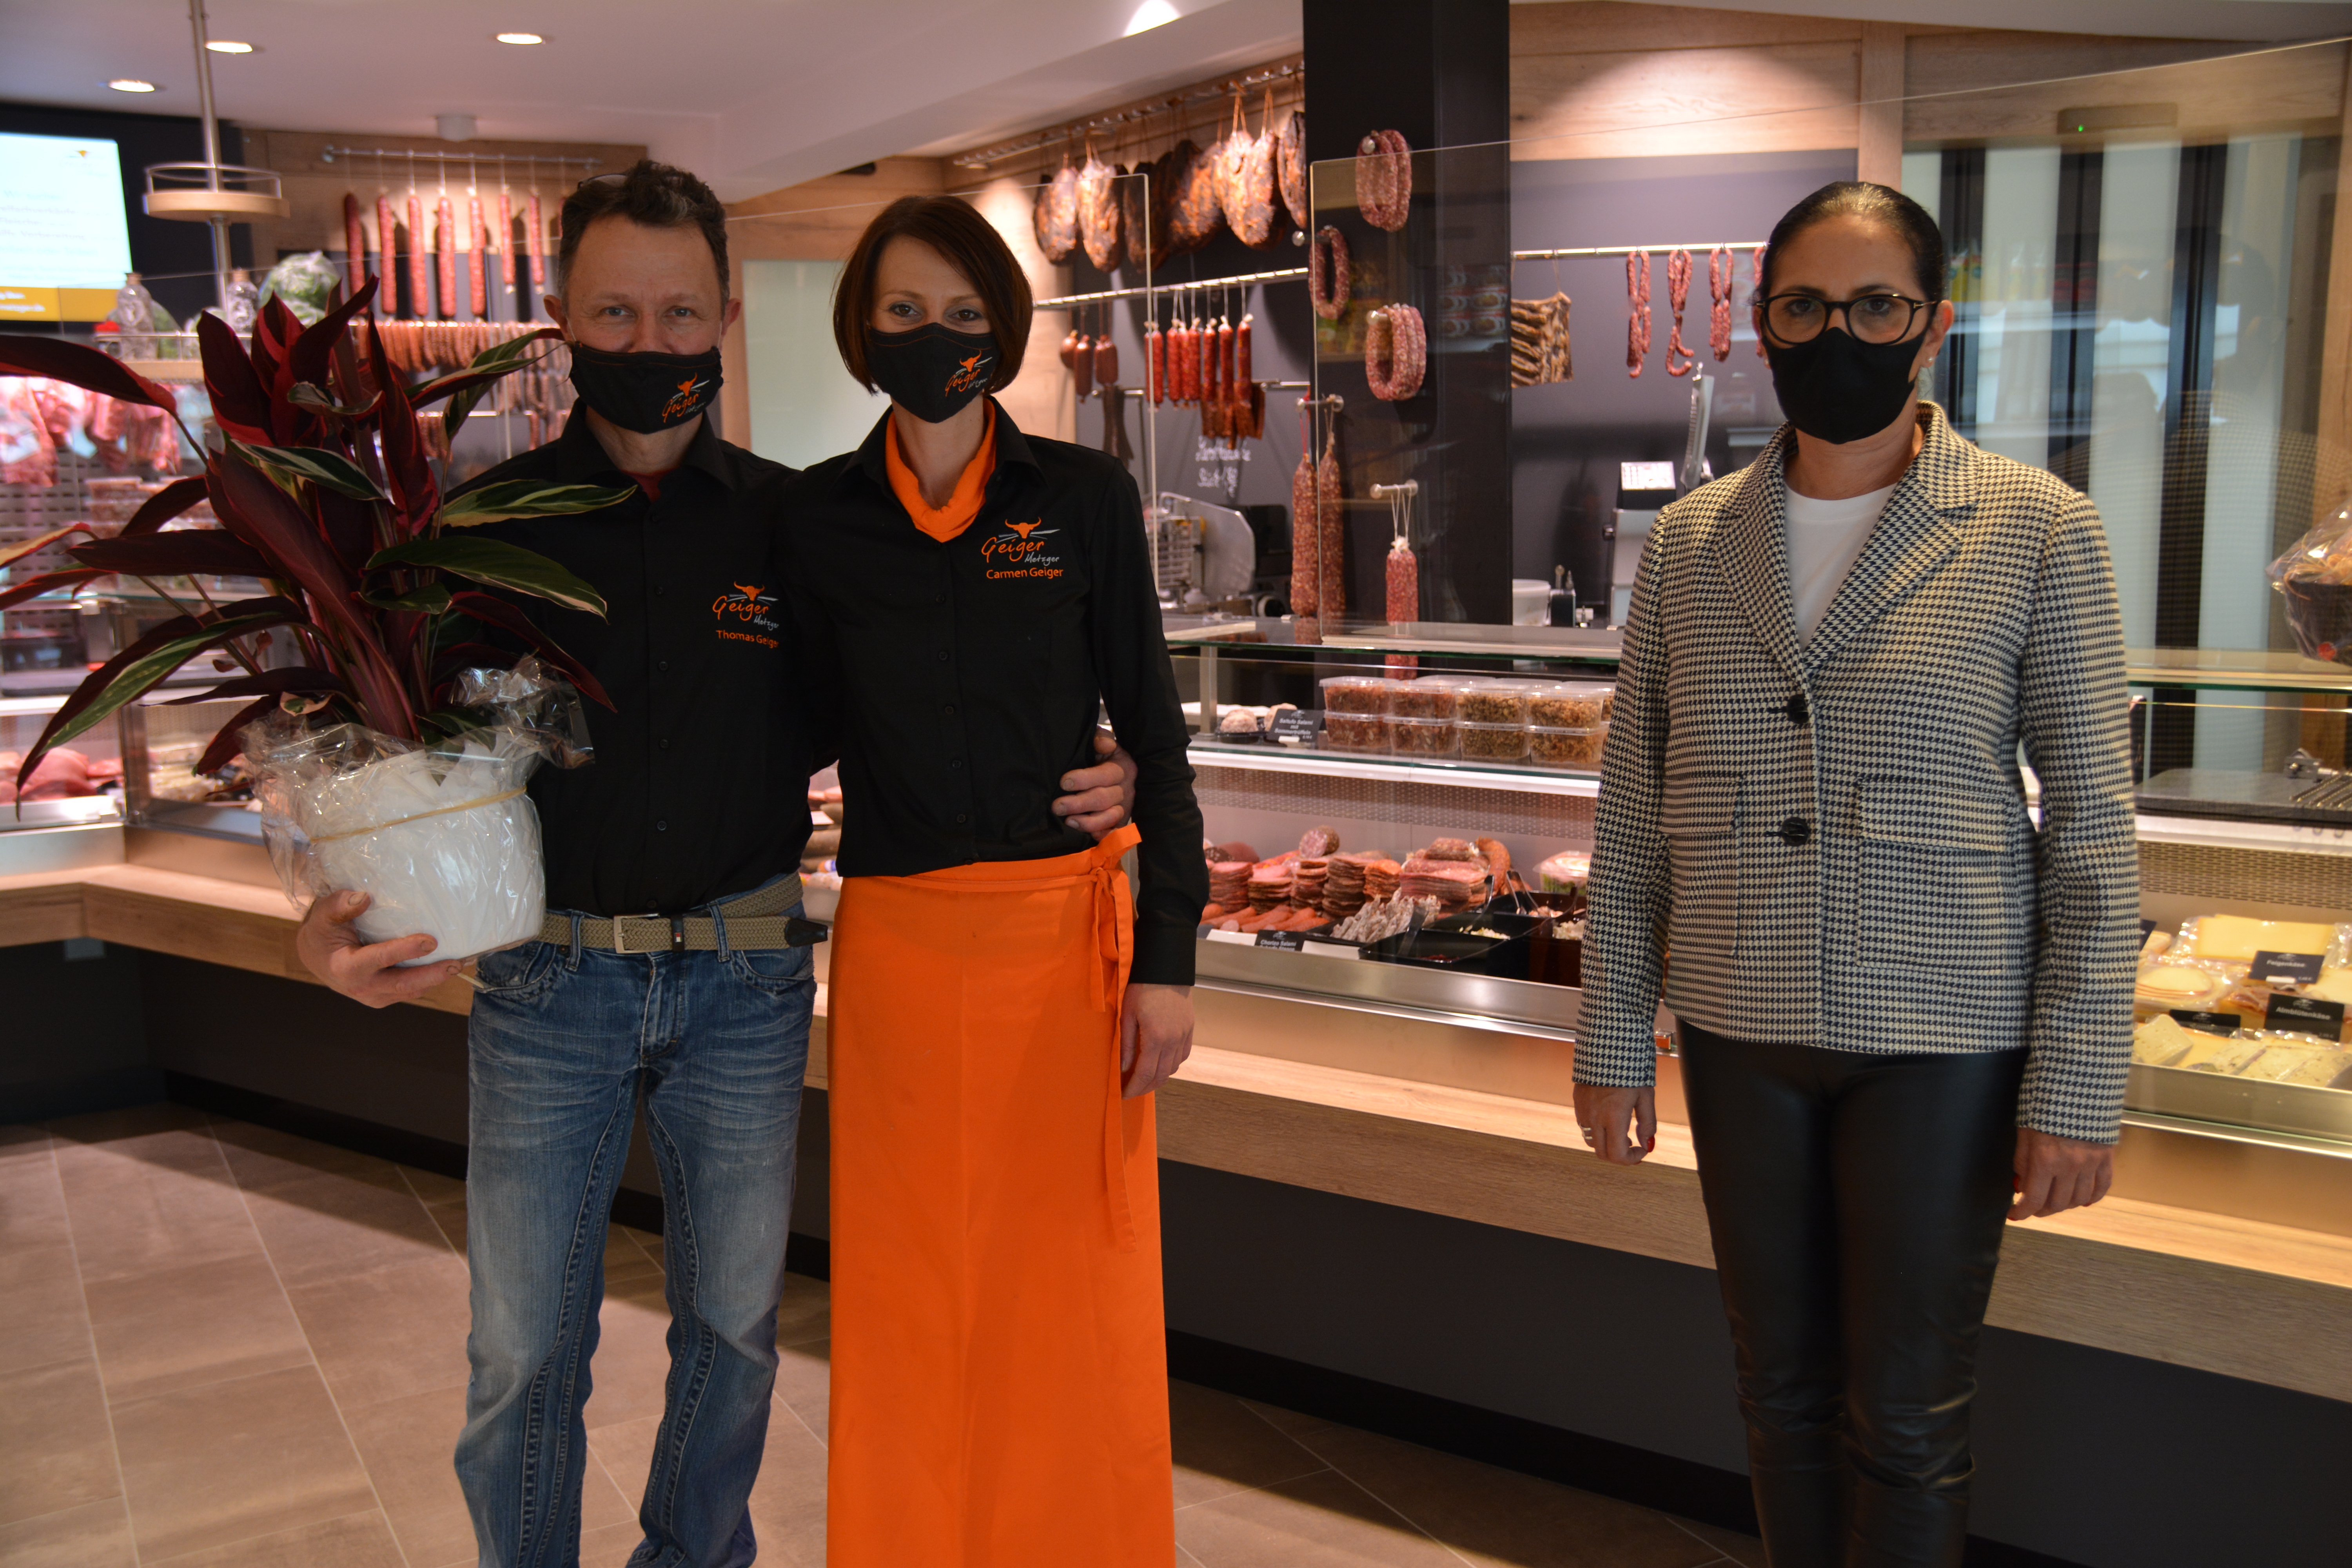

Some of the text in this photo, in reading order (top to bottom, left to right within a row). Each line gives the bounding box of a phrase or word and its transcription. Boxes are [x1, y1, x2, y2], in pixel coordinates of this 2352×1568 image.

[662, 394, 699, 423] Geiger
[981, 537, 1044, 563] Geiger
[1024, 552, 1059, 566] Metzger
[986, 567, 1063, 579] Carmen Geiger
[712, 595, 769, 621] Geiger
[753, 614, 779, 631] Metzger
[716, 630, 779, 649] Thomas Geiger
[2275, 1006, 2331, 1020] Almblütenkäse
